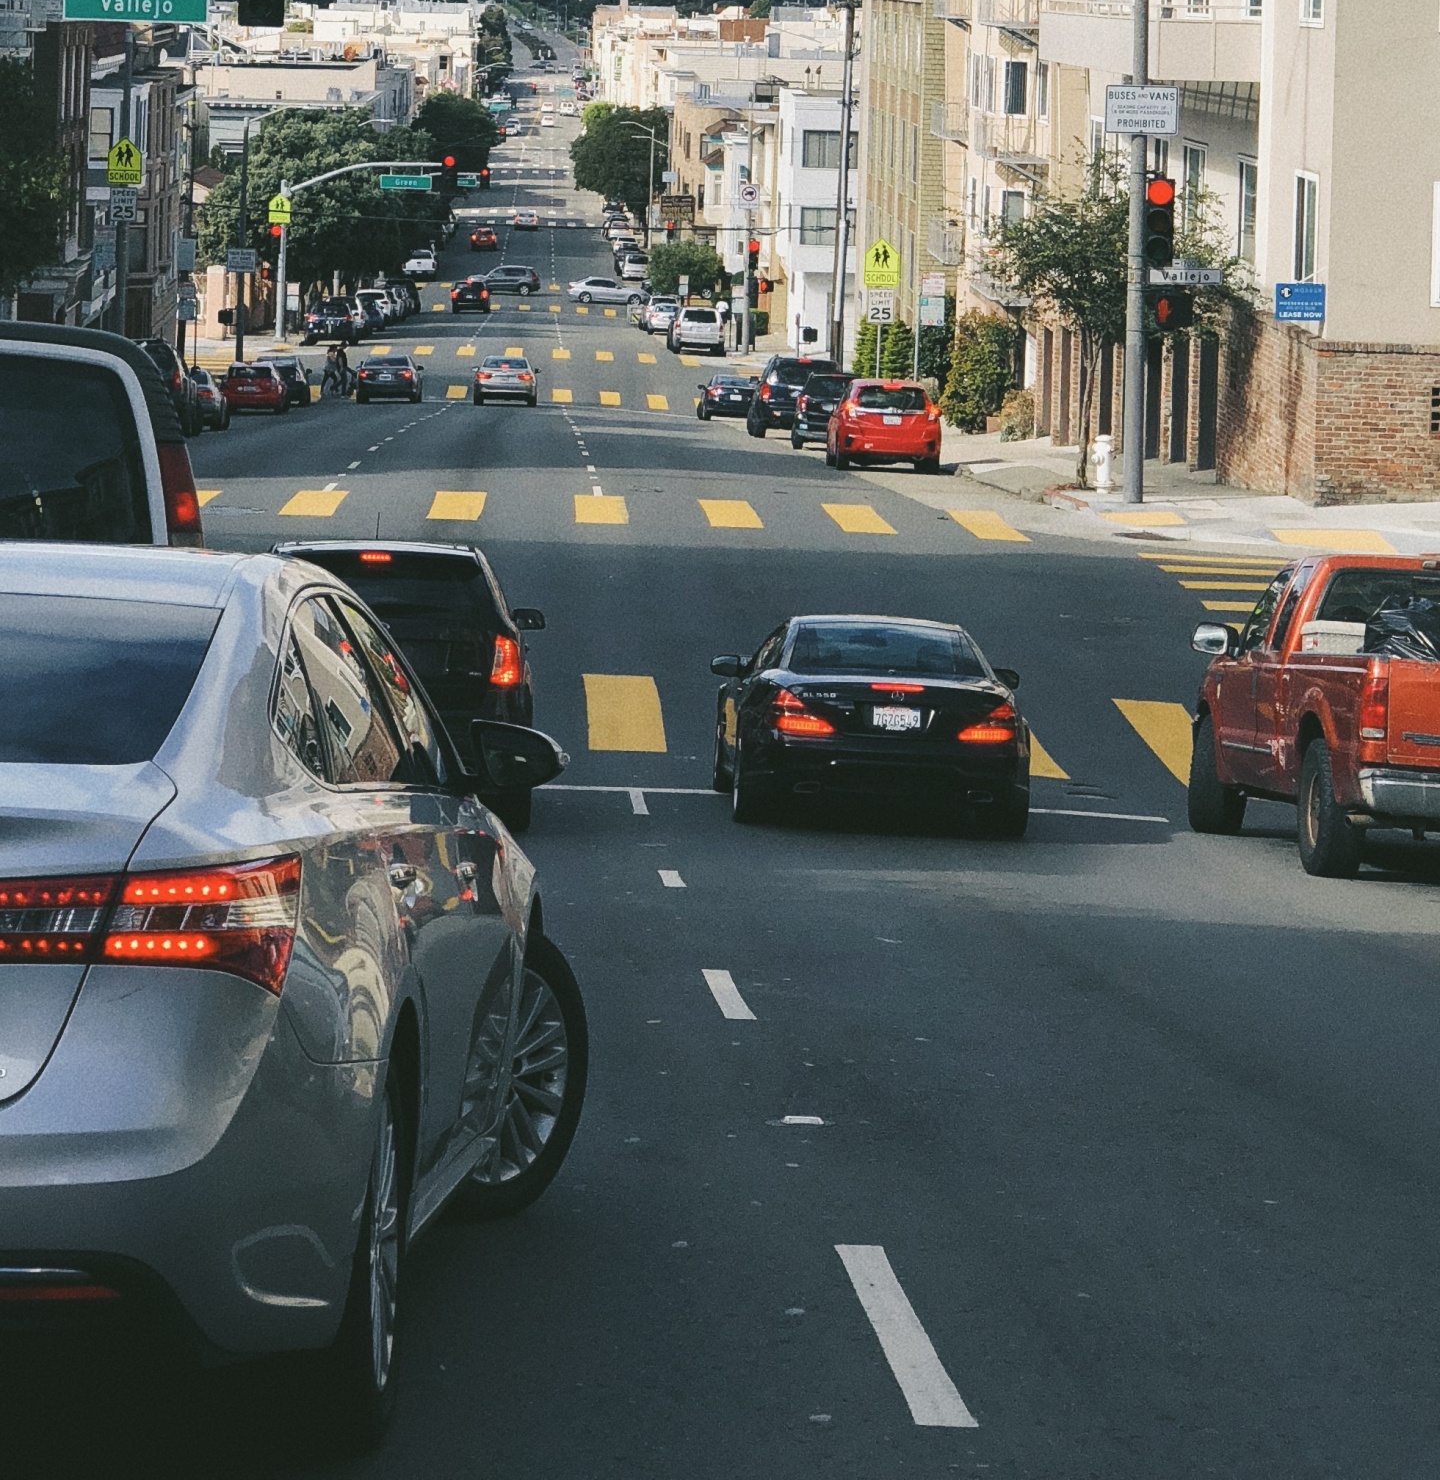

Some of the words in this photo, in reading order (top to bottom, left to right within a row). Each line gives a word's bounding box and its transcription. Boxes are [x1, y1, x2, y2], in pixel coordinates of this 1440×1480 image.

[1108, 90, 1136, 100] BUSES
[1149, 91, 1176, 101] VANS
[1117, 119, 1166, 128] PROHIBITED
[109, 172, 140, 181] SCHOOL
[394, 178, 418, 186] Green
[112, 206, 135, 220] 25
[866, 273, 896, 283] SCHOOL
[1161, 271, 1210, 283] Vallejo
[870, 307, 891, 322] 25
